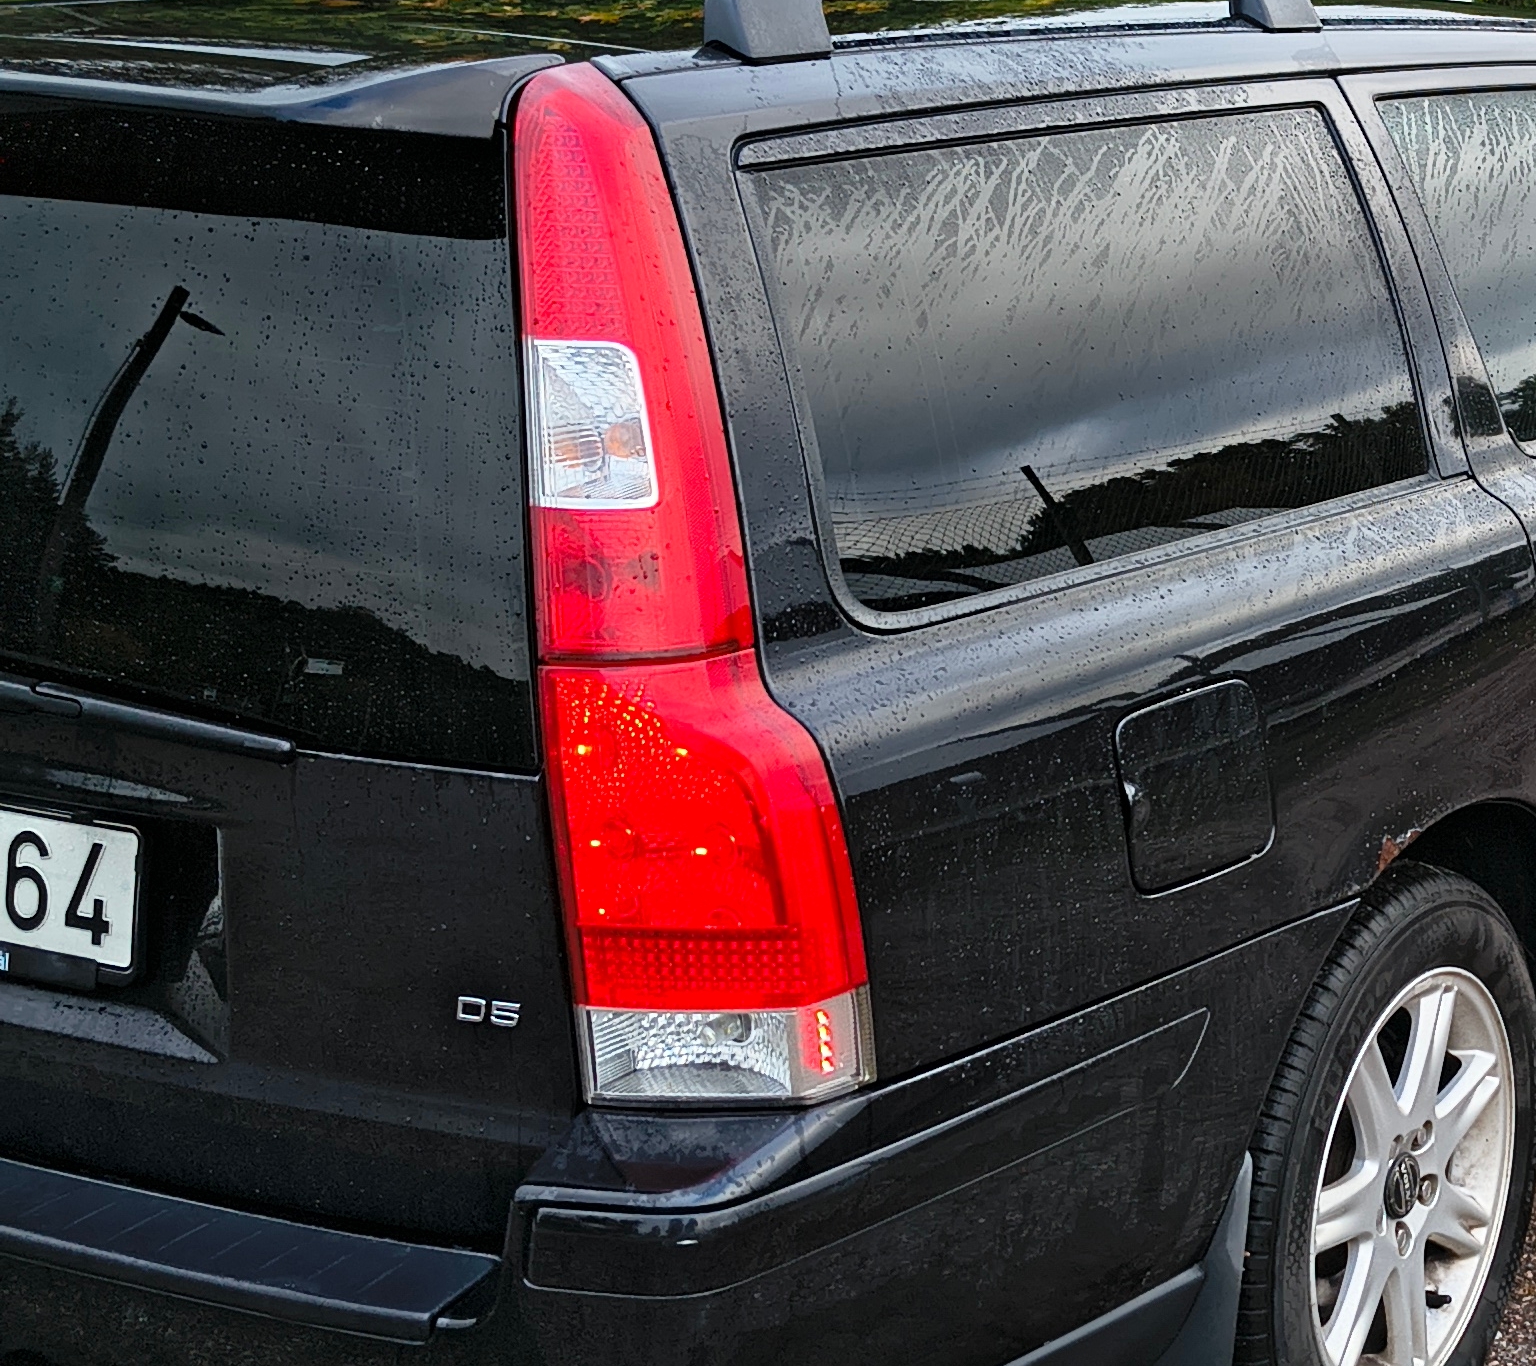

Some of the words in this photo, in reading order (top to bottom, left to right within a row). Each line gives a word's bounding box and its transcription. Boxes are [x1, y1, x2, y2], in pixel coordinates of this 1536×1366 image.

[5, 830, 112, 946] 64
[457, 996, 520, 1027] D5
[1313, 969, 1396, 1133] KUMHO
